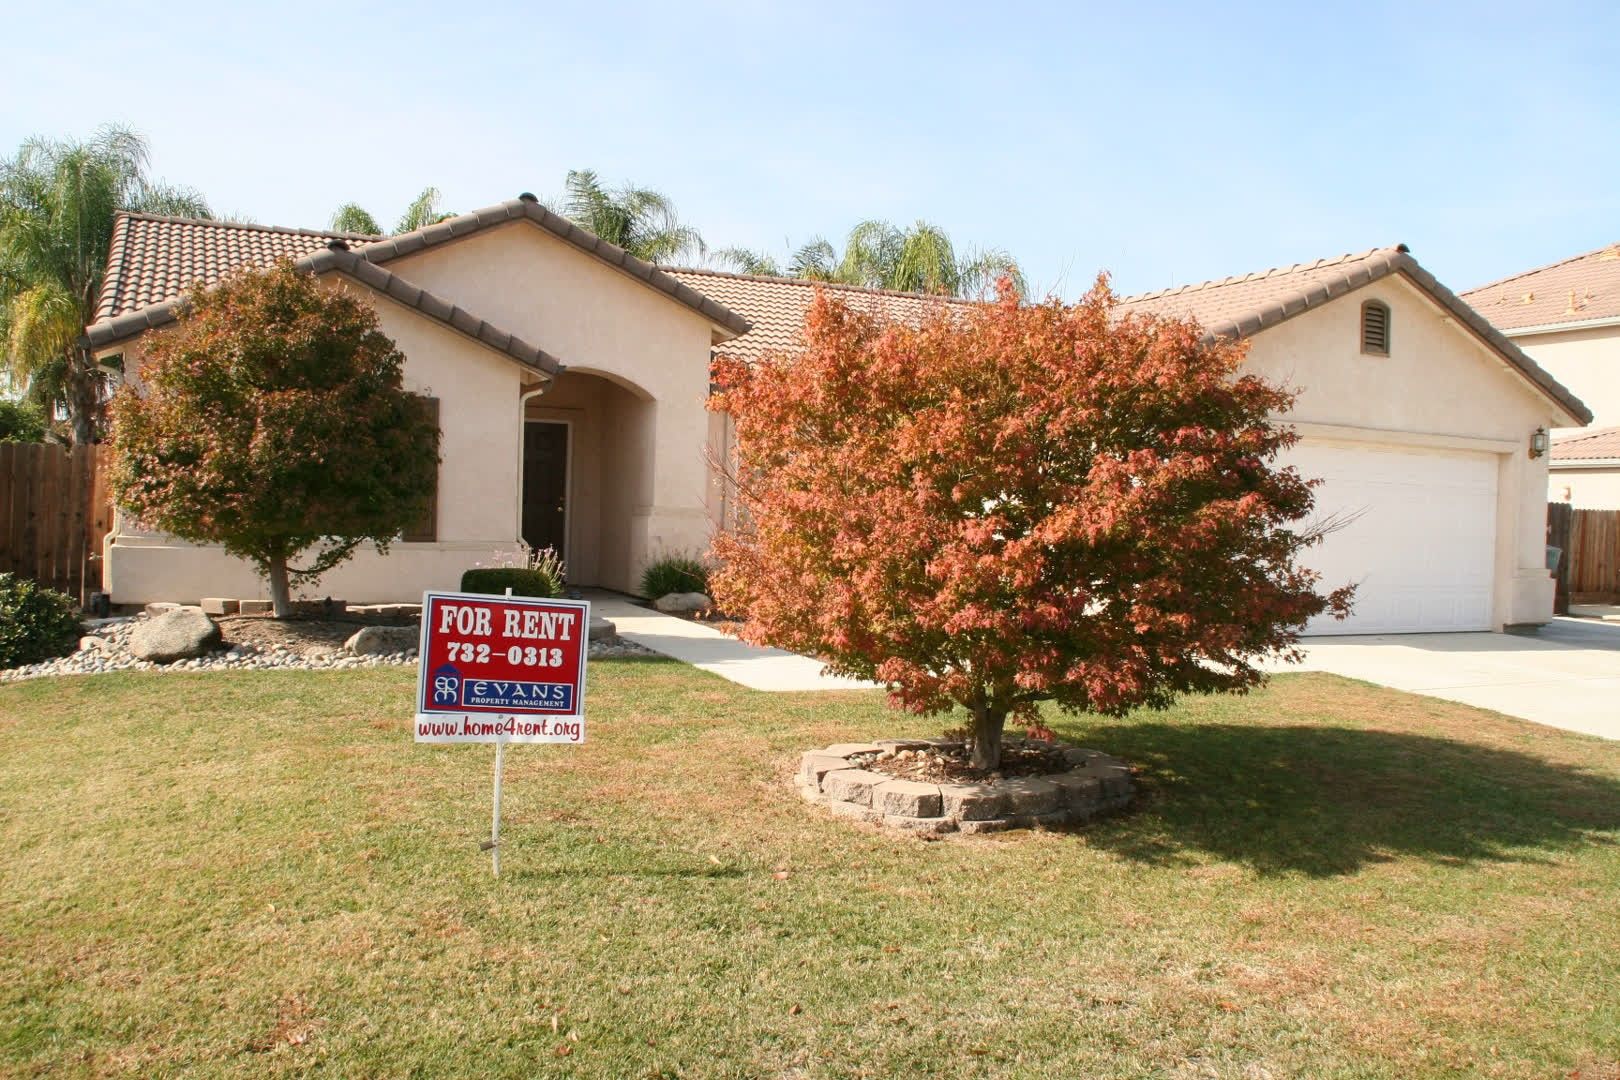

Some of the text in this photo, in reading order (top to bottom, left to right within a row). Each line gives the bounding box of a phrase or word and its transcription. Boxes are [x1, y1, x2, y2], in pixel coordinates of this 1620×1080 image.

[439, 605, 575, 641] FOR RENT
[447, 641, 563, 667] 732-0313
[471, 697, 565, 707] PROPERTY MANAGEMENT
[473, 681, 565, 699] EVANS
[418, 715, 580, 741] www.home4rent.org
